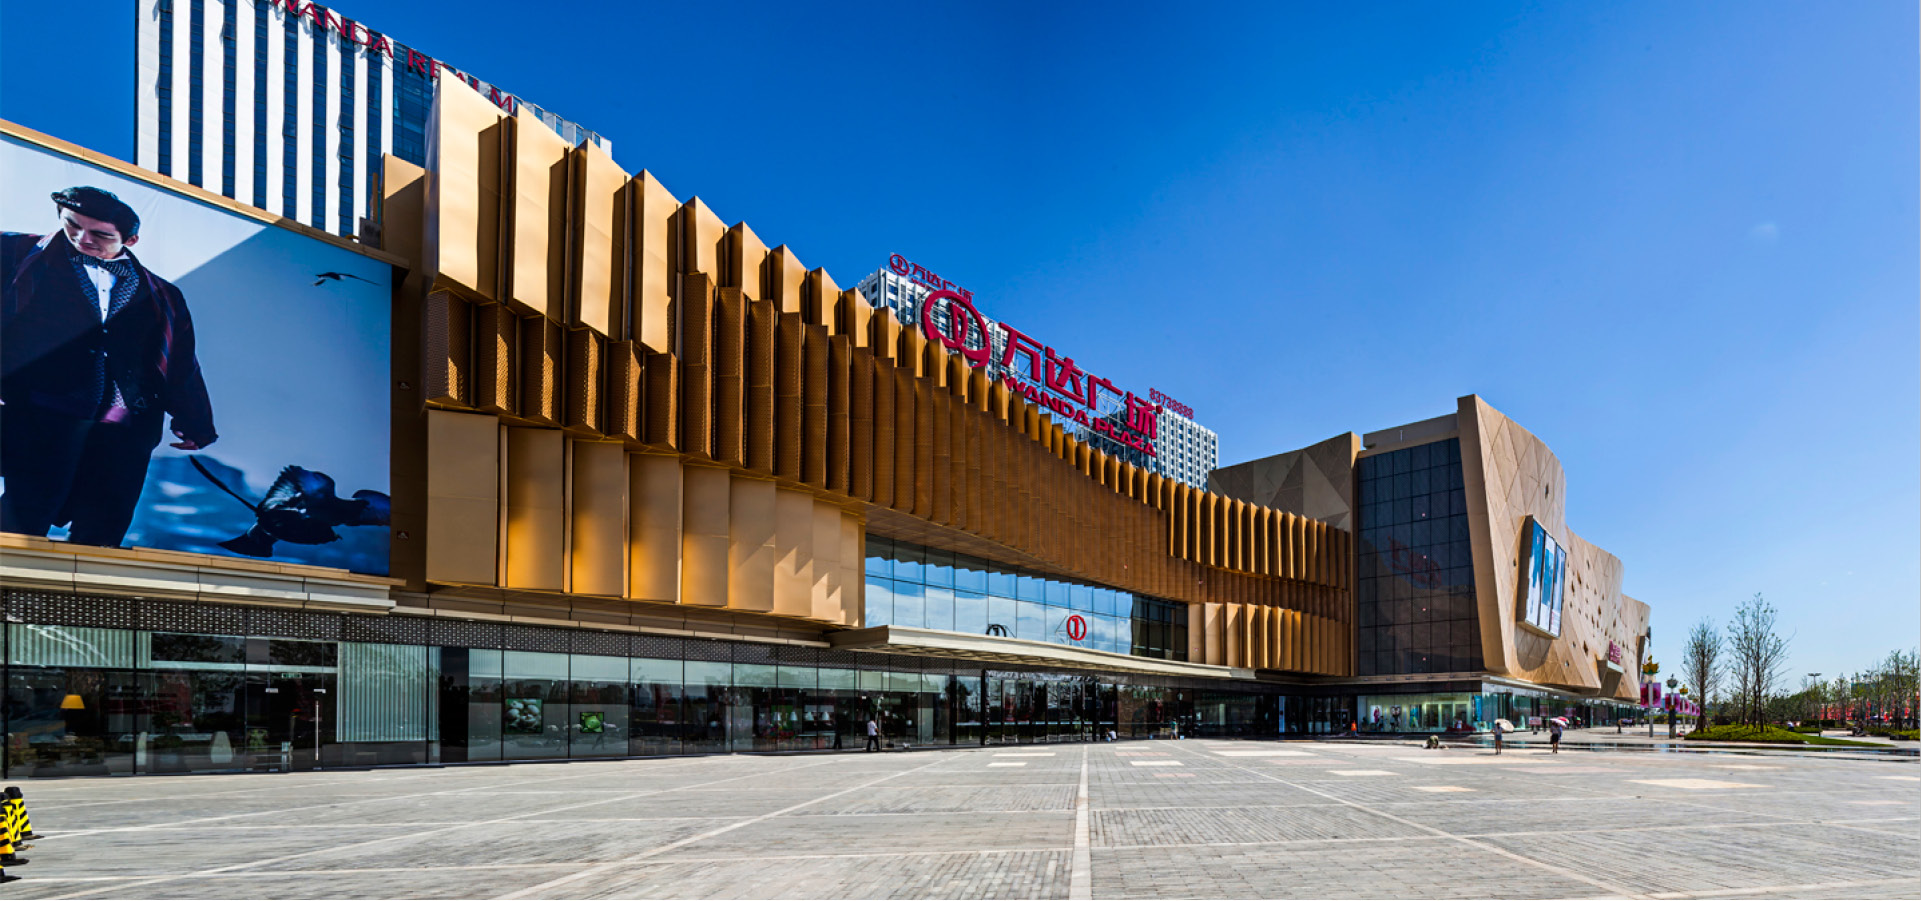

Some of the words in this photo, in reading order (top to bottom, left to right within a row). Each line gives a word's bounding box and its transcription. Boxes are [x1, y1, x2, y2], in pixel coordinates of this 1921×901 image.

[910, 262, 975, 303] 万达广场
[998, 321, 1157, 440] 万达广场
[1149, 387, 1194, 420] 83738888
[1000, 371, 1090, 427] WANDA
[1093, 417, 1157, 458] PLAZA
